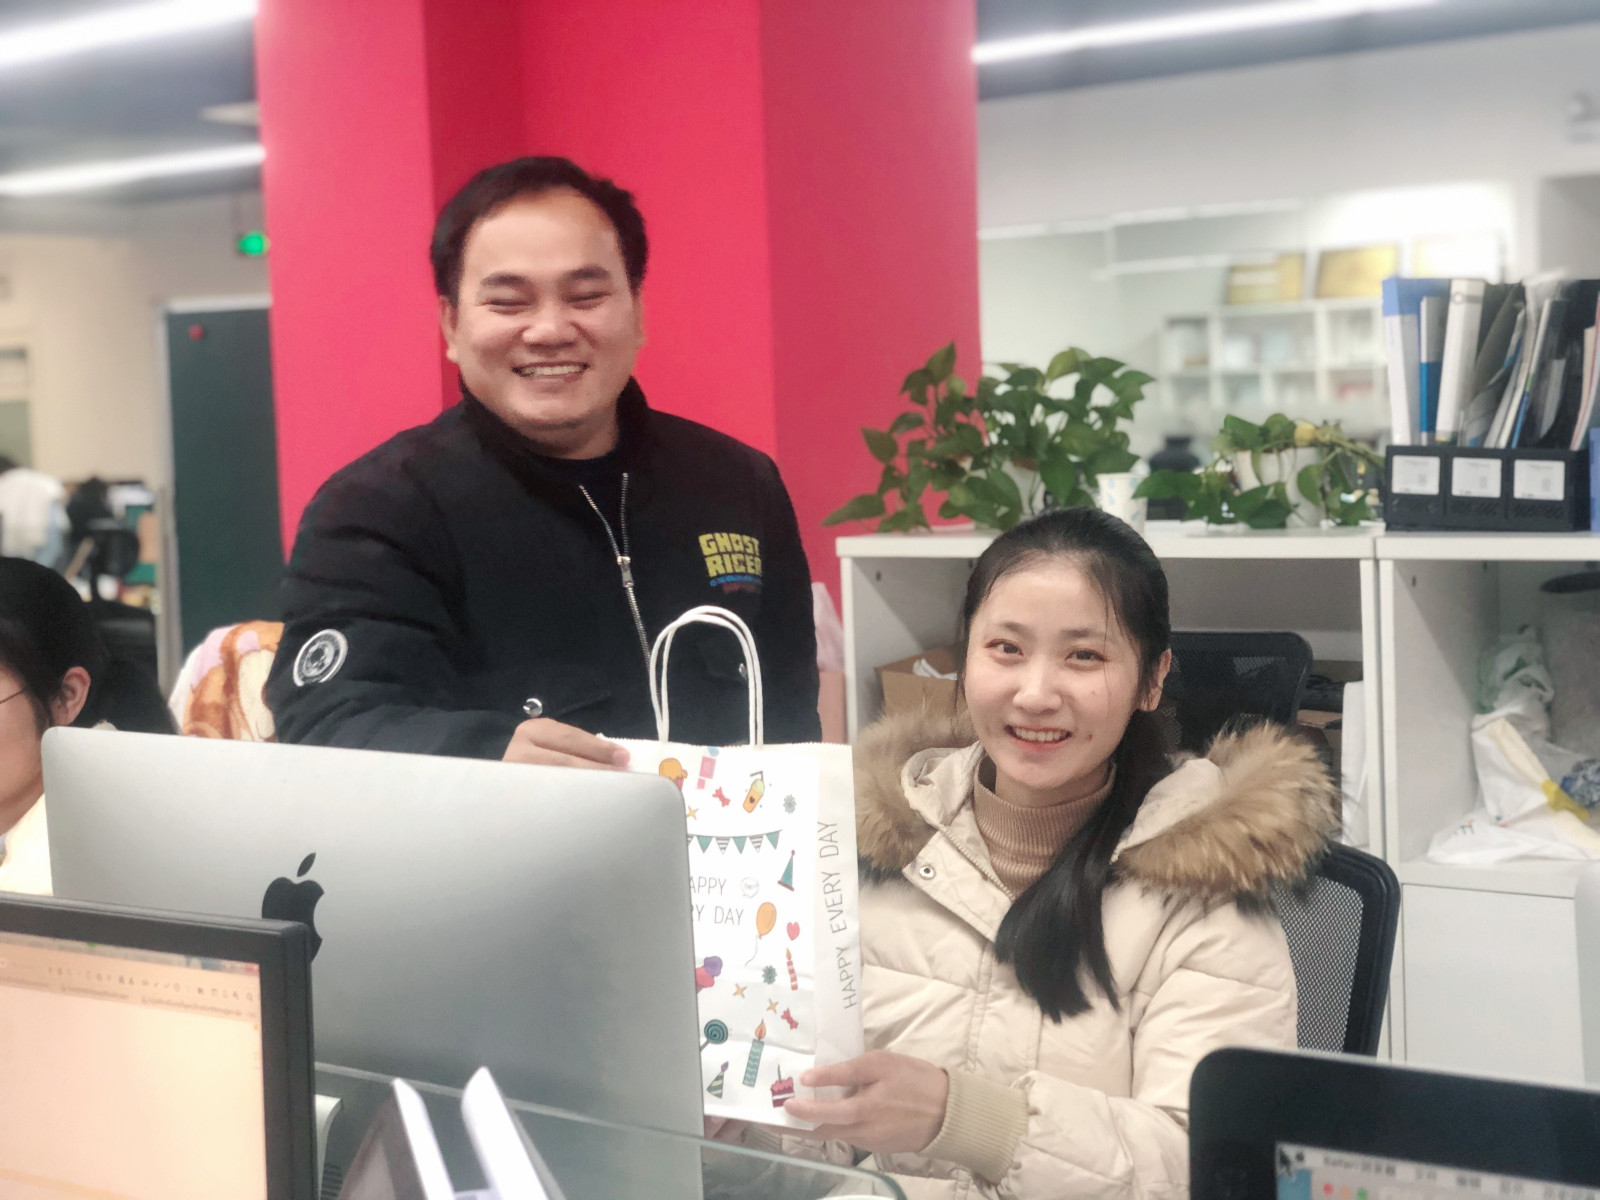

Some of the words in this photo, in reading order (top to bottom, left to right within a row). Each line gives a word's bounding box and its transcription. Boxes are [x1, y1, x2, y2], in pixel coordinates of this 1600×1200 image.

[698, 532, 760, 557] GHOST
[817, 821, 839, 858] DAY
[690, 876, 727, 896] APPY
[714, 905, 744, 926] DAY
[821, 871, 847, 934] EVERY
[835, 946, 857, 1009] HAPPY
